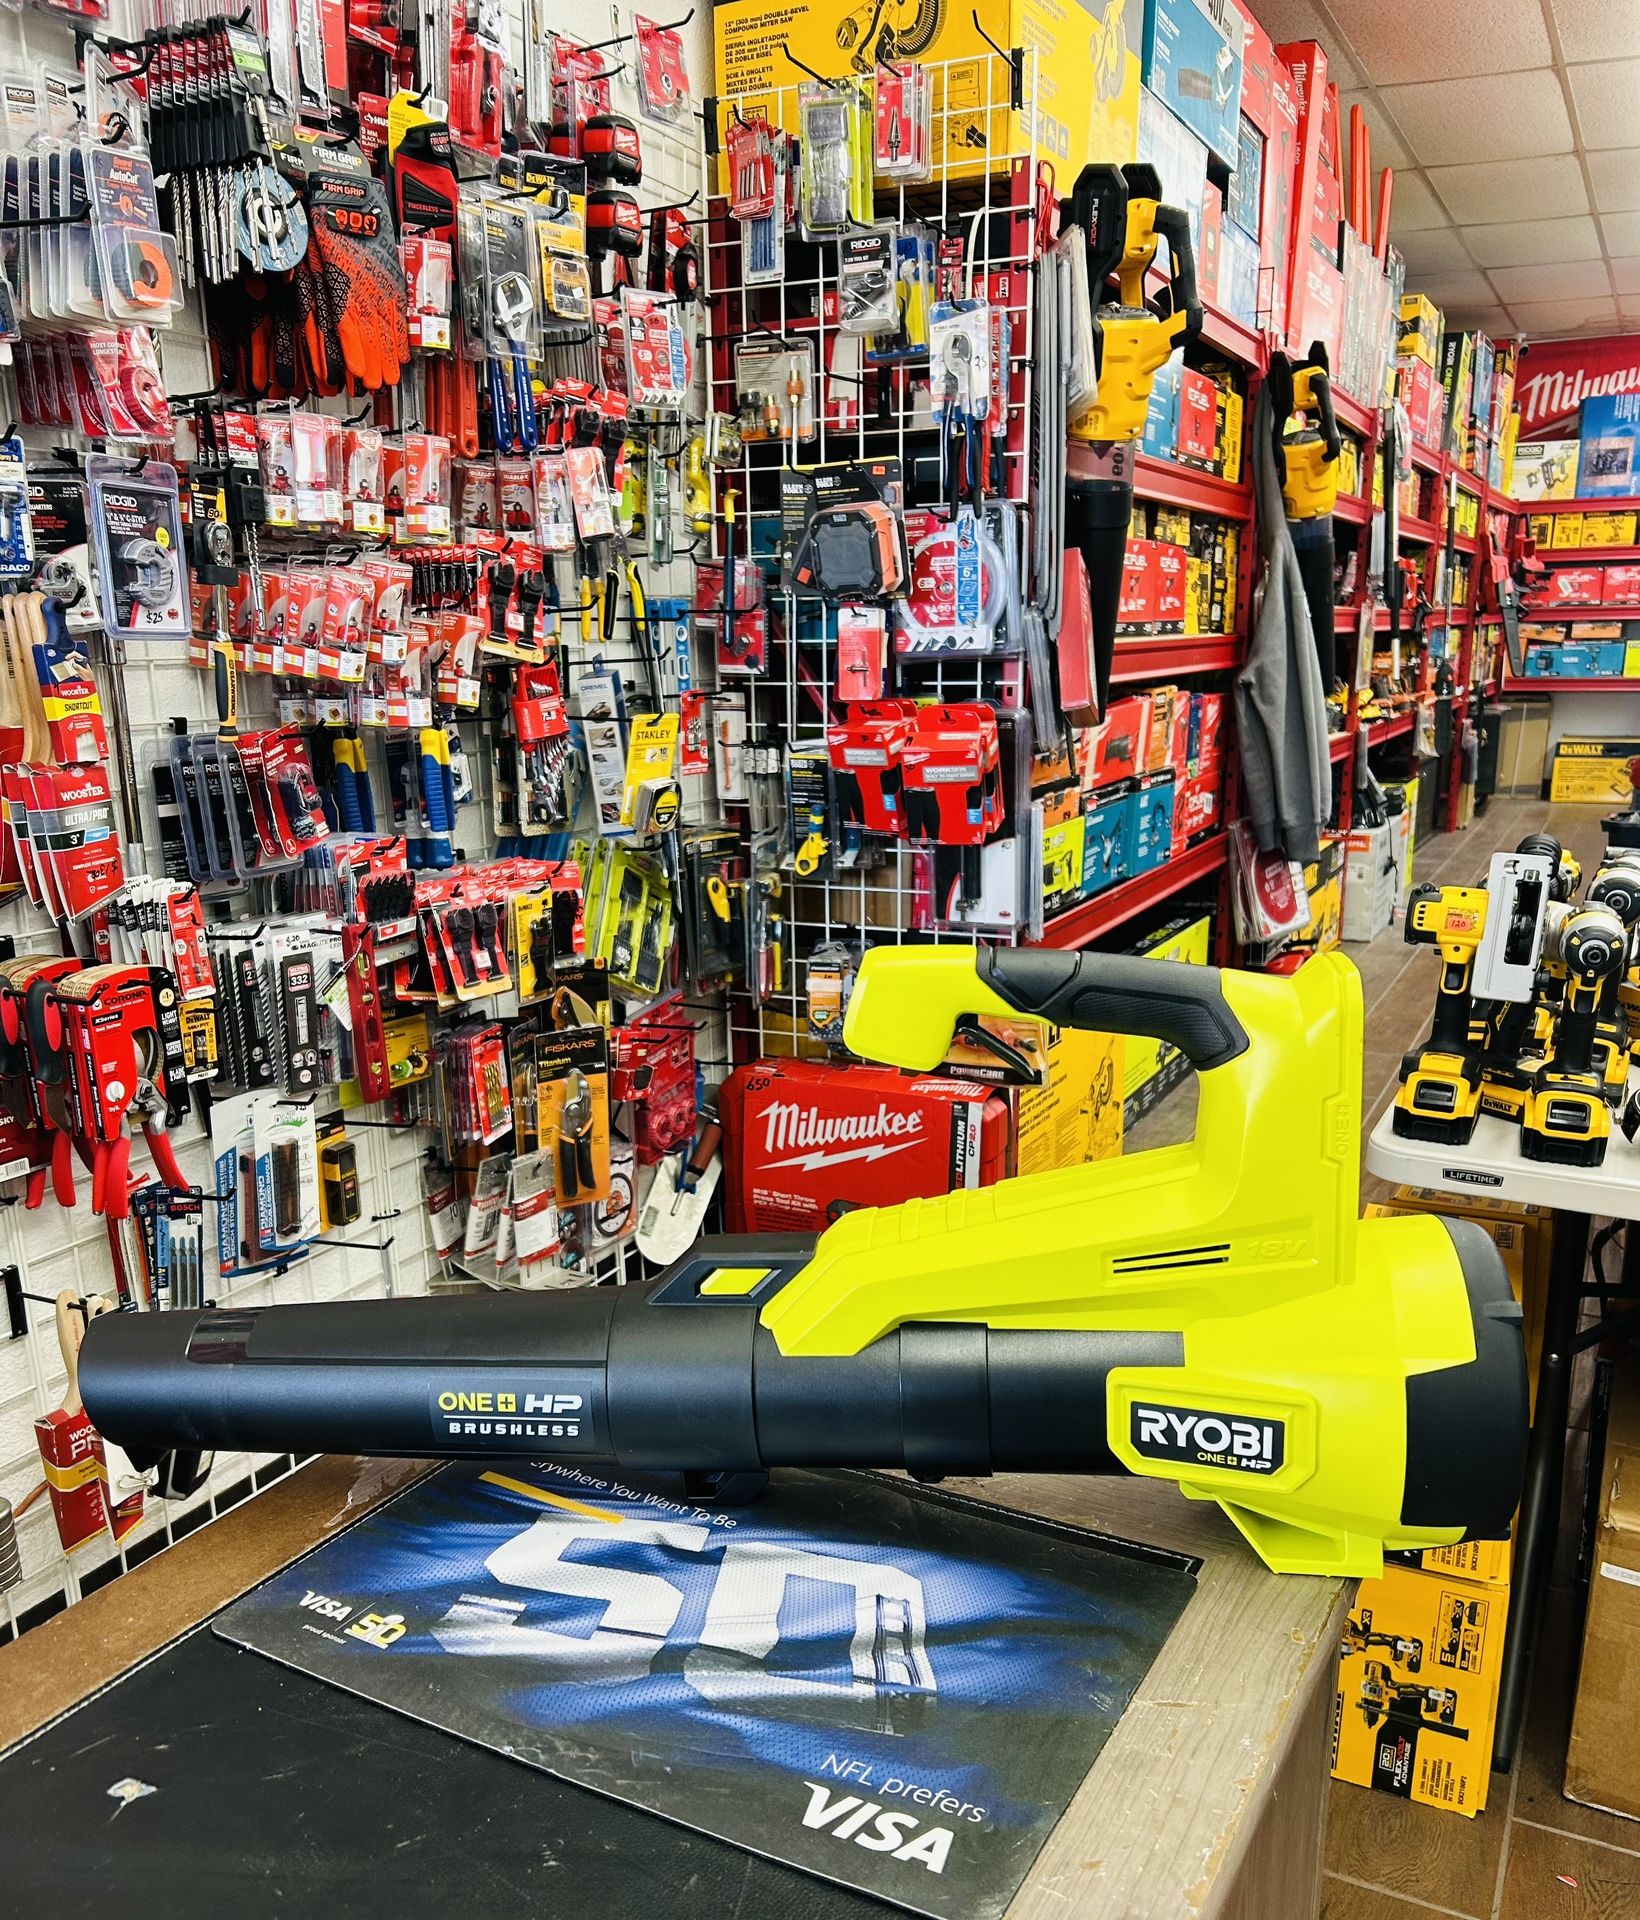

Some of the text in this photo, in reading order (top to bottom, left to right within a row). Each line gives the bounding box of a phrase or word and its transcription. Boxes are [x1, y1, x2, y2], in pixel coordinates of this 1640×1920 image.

[763, 5, 810, 20] DOUBLE-BEVEL
[724, 16, 794, 35] COMPOUND MITER SAW
[725, 32, 789, 50] SIERRA INGLETADORA
[725, 50, 733, 58] DE
[735, 54, 755, 63] DOBLE
[756, 51, 773, 59] BISEL
[726, 65, 773, 80] SCIE ONGLETS
[726, 79, 748, 88] MIXTES
[726, 81, 773, 95] BISEAU DOUBLE
[1288, 59, 1308, 116] Milwaukee
[312, 146, 362, 166] FIRM GRIP
[322, 183, 364, 196] FIRM GRIP
[408, 203, 439, 213] FINGERLESS
[838, 225, 850, 234] 20
[1089, 198, 1099, 247] FLEXVOLT
[850, 238, 881, 250] RIDGID
[1446, 341, 1457, 366] RYOBI
[1519, 366, 1640, 423] Milwau
[104, 494, 137, 507] RIDGID
[0, 564, 30, 572] RACO
[146, 611, 163, 624] $25
[61, 686, 89, 696] WOOSTER
[580, 682, 608, 692] DREMEL
[64, 701, 93, 712] SHORTCUT
[636, 729, 671, 740] STANLEY
[1560, 744, 1604, 756] DEWALT
[183, 766, 196, 775] RID
[205, 764, 219, 772] RID
[60, 784, 105, 801] WOOSTER
[65, 808, 109, 826] ULTRA/PRO
[1451, 919, 1467, 929] 120
[300, 940, 328, 949] MAGLITE
[291, 975, 308, 986] 332
[104, 990, 148, 1006] CORONA
[161, 1010, 177, 1020] LIGHT
[186, 1014, 210, 1025] DEWALT
[545, 1040, 597, 1054] FISKARS
[539, 1057, 571, 1069] Titanium
[745, 1076, 770, 1092] 650
[1484, 1098, 1513, 1114] DEWALT
[0, 1116, 14, 1126] SKY
[755, 1100, 923, 1153] Milwaukee
[954, 1120, 966, 1188] EDLITHIUM
[227, 1152, 235, 1201] SARPENER
[1450, 1171, 1496, 1185] LIFETIME
[753, 1194, 774, 1202] Press
[776, 1197, 790, 1205] Tool
[772, 1191, 792, 1199] Short
[170, 1205, 200, 1213] BOSCH
[258, 1175, 268, 1230] DIAMOND
[220, 1200, 232, 1261] DIAMOND
[1247, 1239, 1306, 1260] 18V
[524, 1394, 583, 1414] HP
[449, 1422, 579, 1437] BRUSHLESS
[1137, 1408, 1273, 1460] RYOBI
[1240, 1457, 1272, 1469] HP
[530, 1461, 737, 1529] rywhere You Want To Be
[299, 1590, 352, 1621] VISA
[302, 1624, 347, 1645] proud sponsor
[1393, 1735, 1405, 1787] FLEXVOLT
[1401, 1742, 1411, 1784] ADVANTAGE
[820, 1754, 986, 1823] NFL prefers
[801, 1781, 955, 1874] VISA
